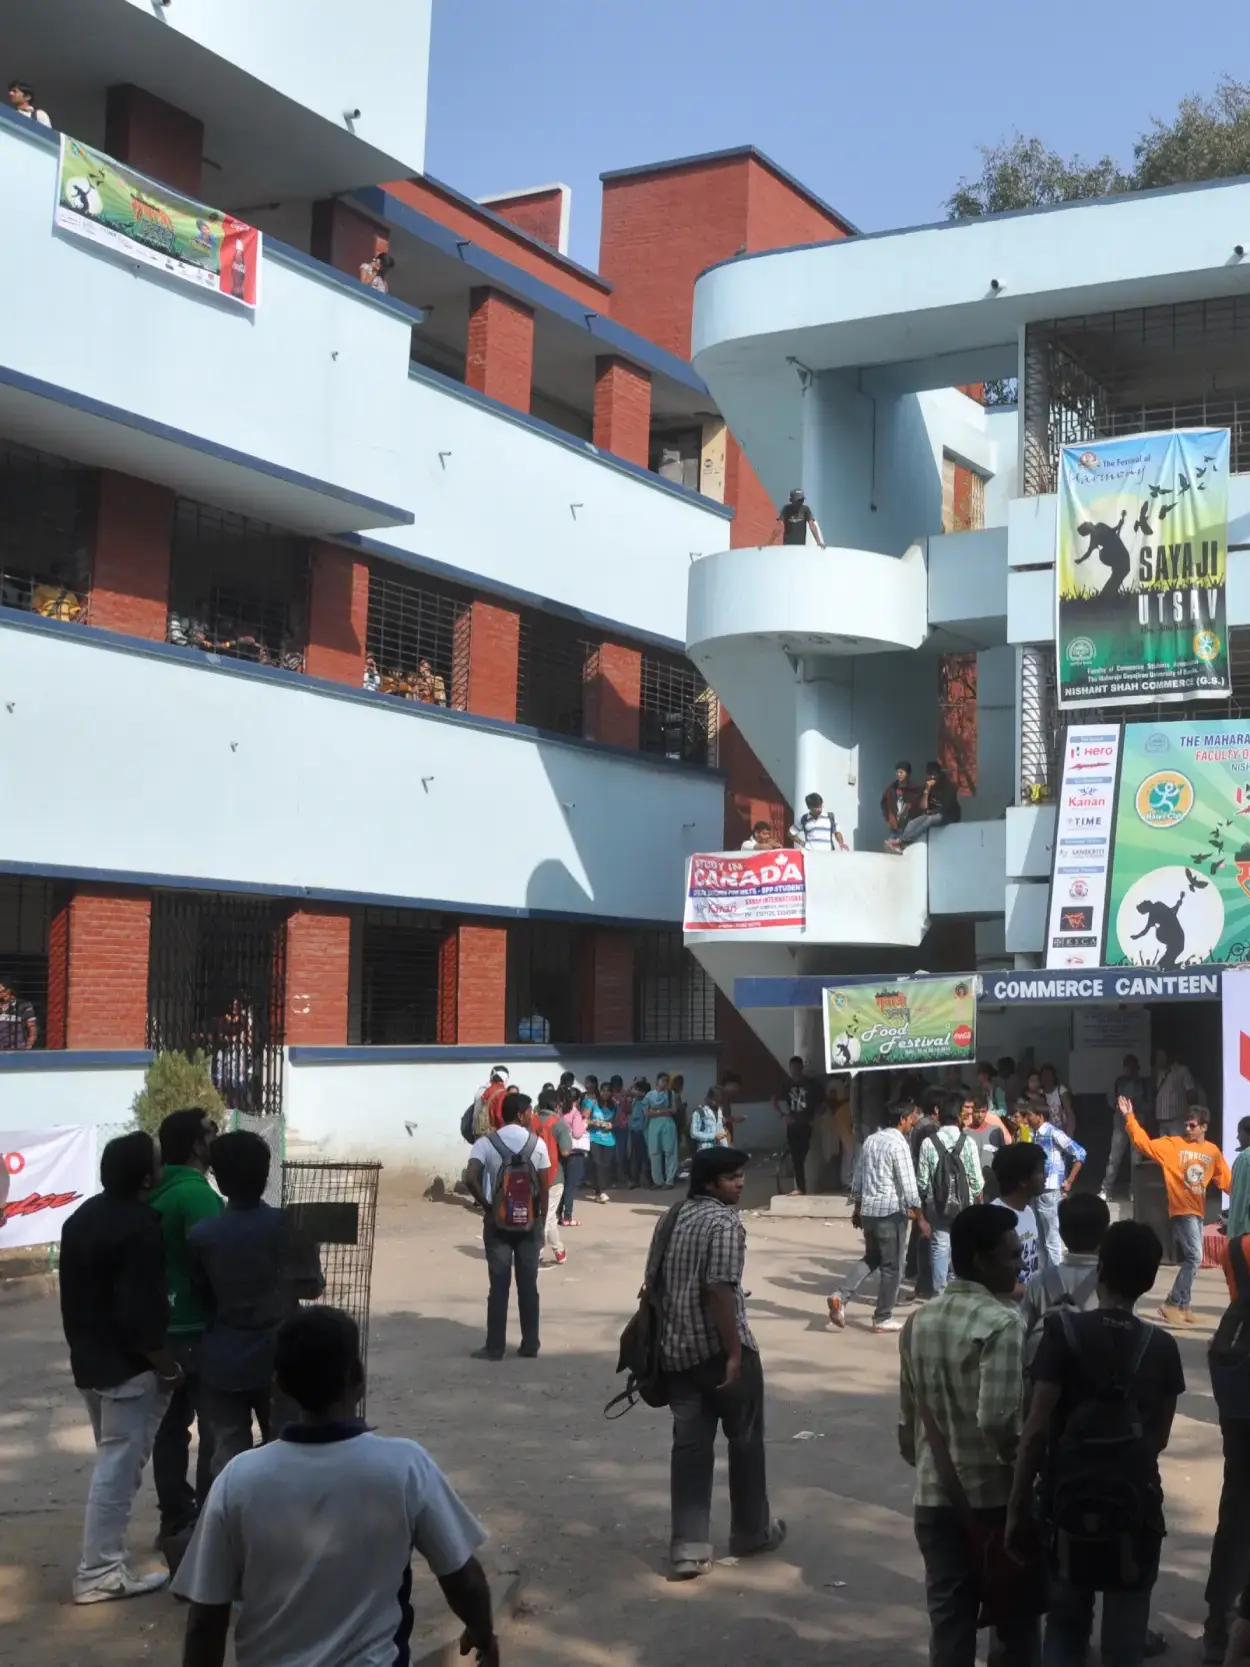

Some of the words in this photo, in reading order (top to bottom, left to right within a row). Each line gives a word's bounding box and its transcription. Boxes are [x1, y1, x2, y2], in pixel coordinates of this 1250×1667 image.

[1103, 460, 1115, 468] The
[1139, 540, 1218, 582] SAYAJI
[1138, 588, 1218, 625] UTSAV
[1065, 685, 1107, 697] NISHANT
[1110, 682, 1139, 693] SHAH
[1141, 678, 1194, 690] COMMERCE
[1196, 676, 1225, 687] (G.S.)
[1181, 735, 1200, 747] THE
[1084, 747, 1113, 756] Hero
[1195, 749, 1239, 761] FACULTY
[1068, 796, 1106, 807] Kanan
[1075, 817, 1102, 825] TIME
[695, 859, 724, 869] STUDY
[694, 863, 803, 888] CANADA
[993, 979, 1104, 999] COMMERCE
[1115, 975, 1218, 996] CANTEEN
[861, 1021, 909, 1041] Food
[880, 1032, 951, 1054] Festival
